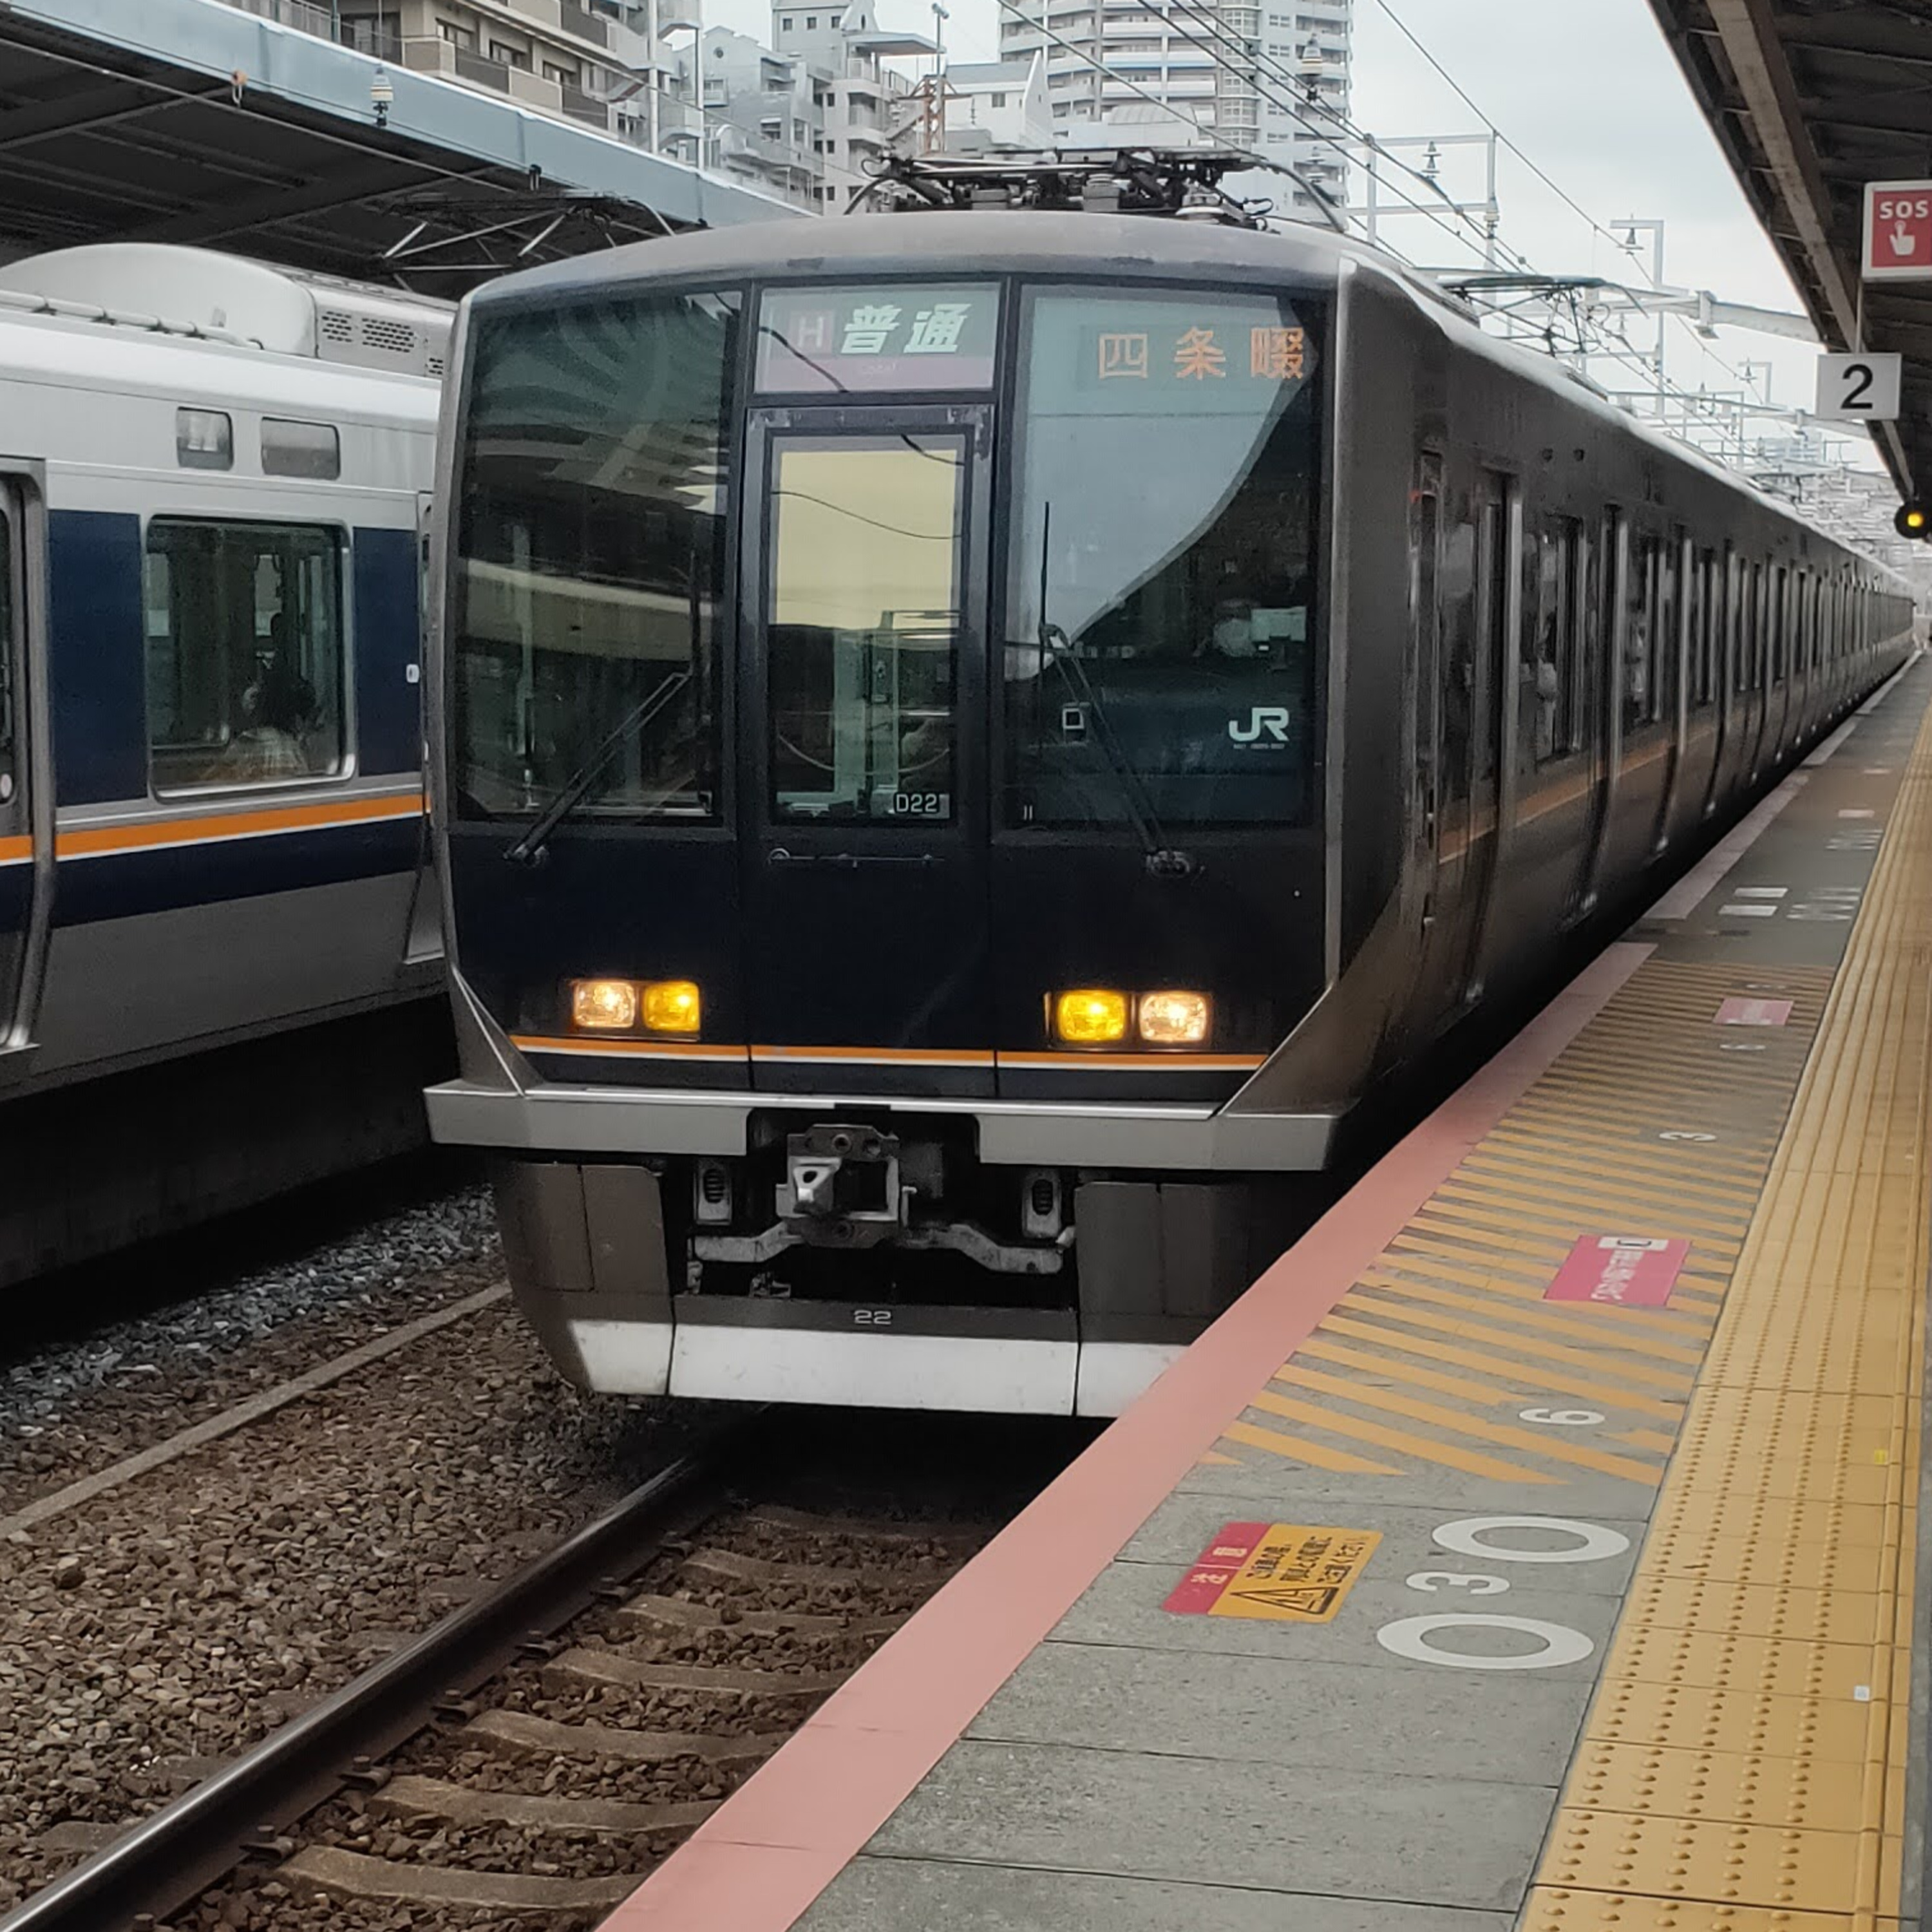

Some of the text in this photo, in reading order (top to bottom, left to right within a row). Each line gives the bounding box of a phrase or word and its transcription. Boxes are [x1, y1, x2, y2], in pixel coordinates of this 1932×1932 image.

[1879, 200, 1929, 219] SOS
[797, 316, 824, 348] H
[840, 303, 972, 354] 普通
[1840, 363, 1873, 410] 2
[1229, 707, 1289, 742] JR
[896, 793, 938, 813] D22
[853, 1309, 892, 1325] 22
